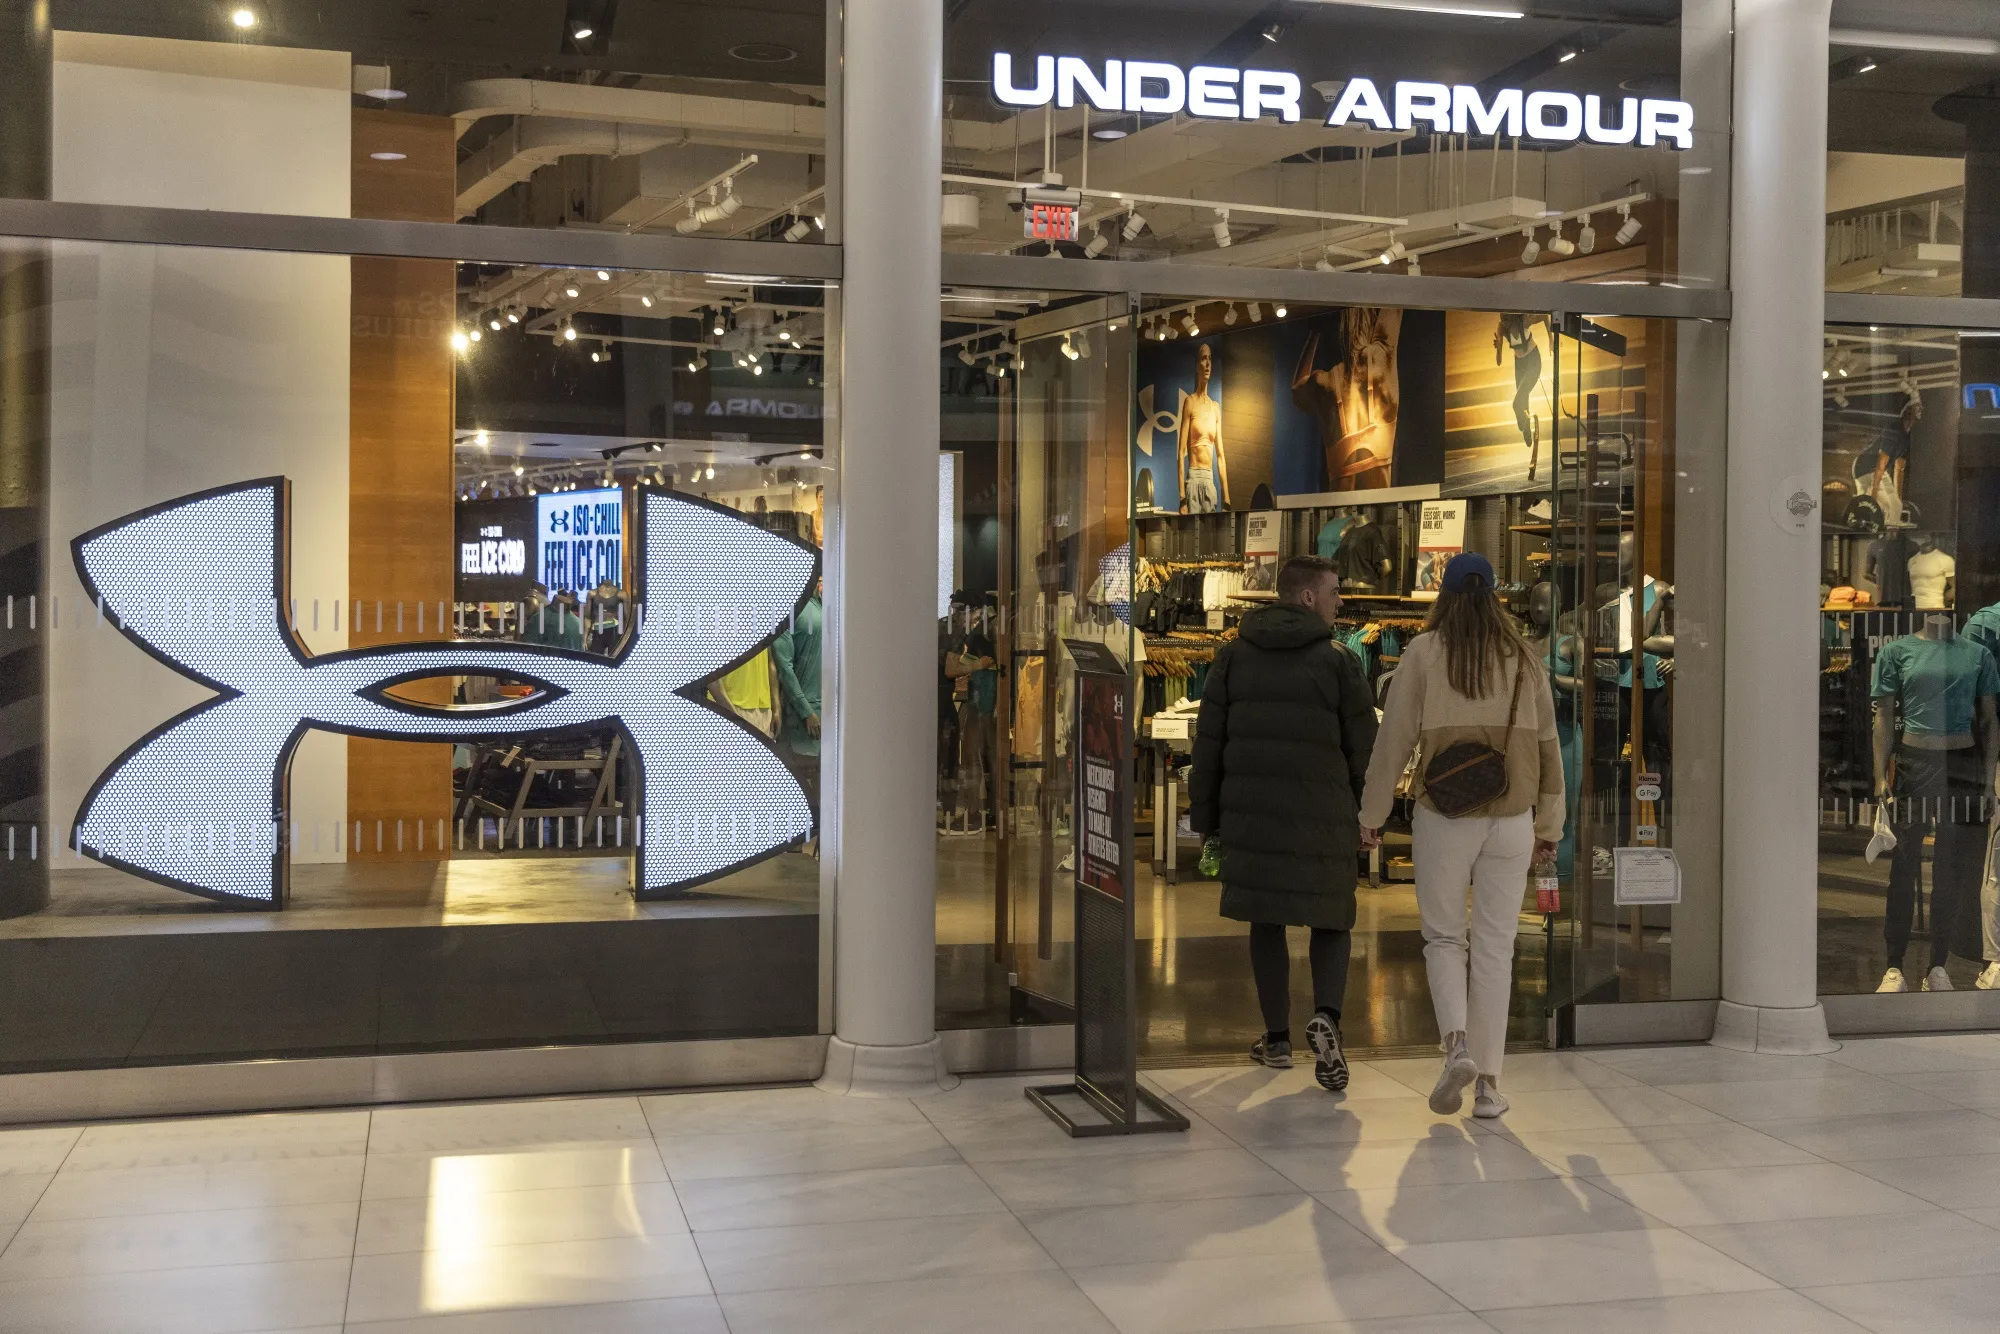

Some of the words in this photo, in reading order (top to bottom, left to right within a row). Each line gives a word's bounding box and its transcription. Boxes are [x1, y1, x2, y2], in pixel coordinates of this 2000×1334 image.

[993, 52, 1300, 122] UNDER
[1328, 78, 1693, 149] ARMOUR
[1032, 204, 1072, 240] EXIT
[573, 502, 621, 536] ISO-CHILL
[544, 540, 569, 591] FEEL
[573, 539, 593, 591] ICE
[1646, 789, 1658, 798] Pay
[1643, 829, 1654, 837] Pay
